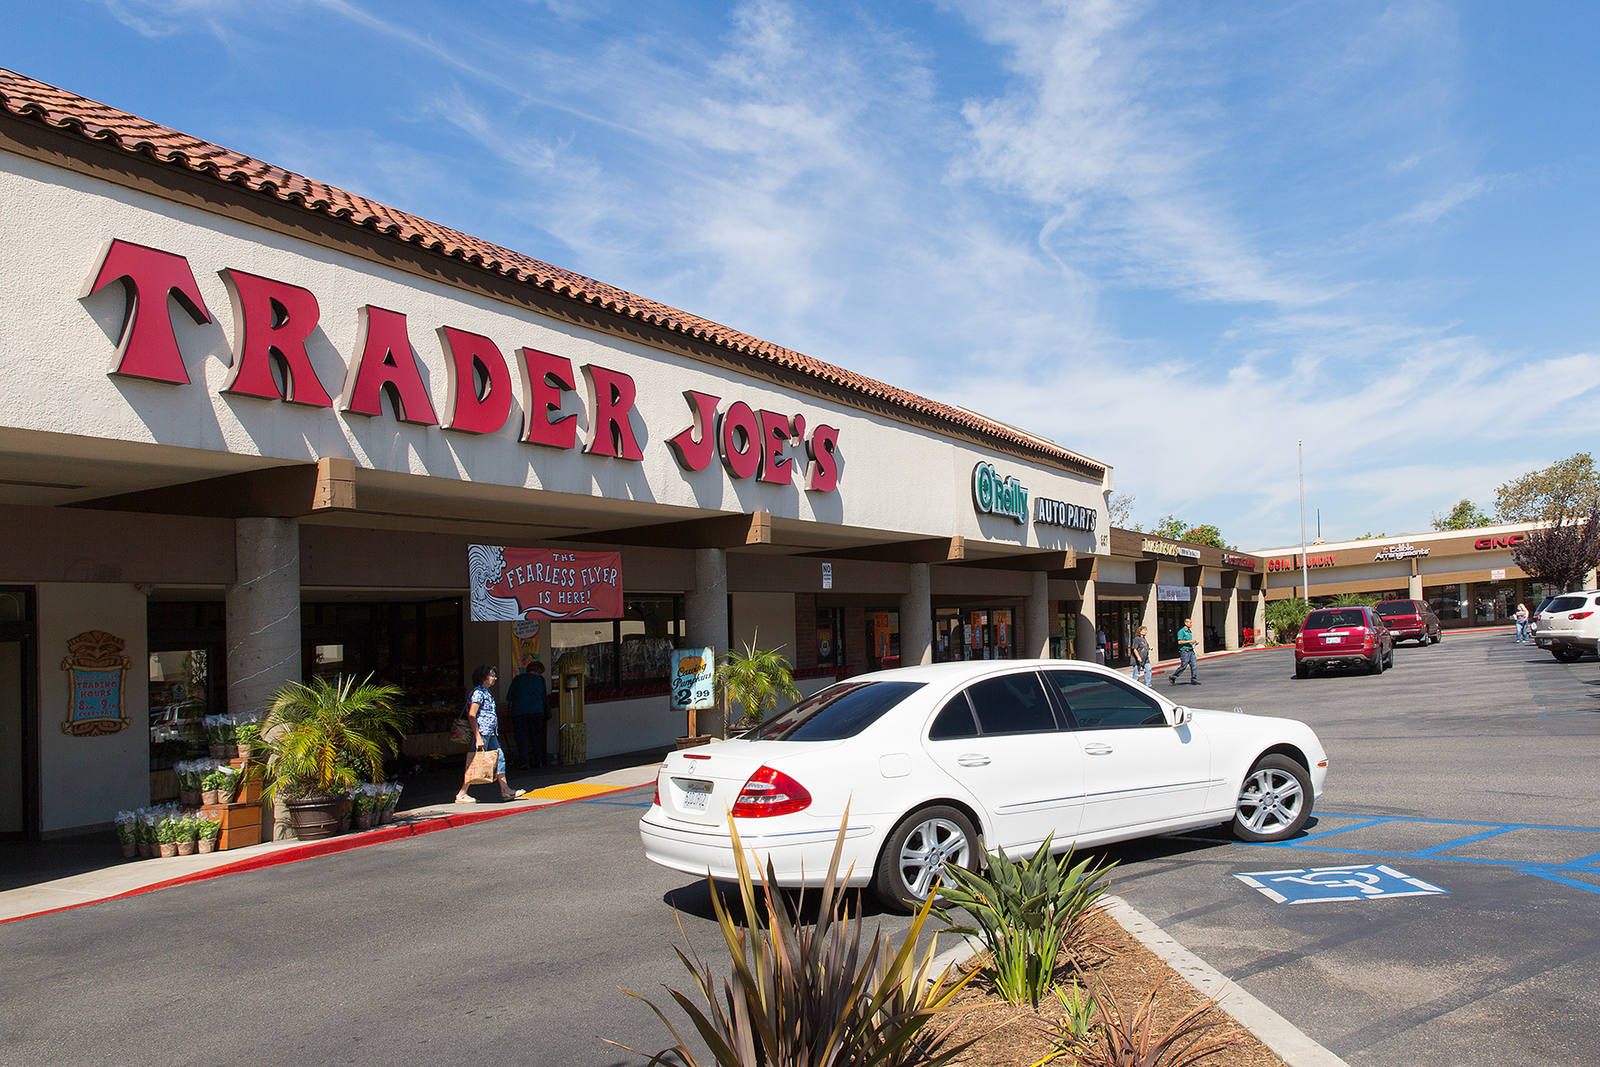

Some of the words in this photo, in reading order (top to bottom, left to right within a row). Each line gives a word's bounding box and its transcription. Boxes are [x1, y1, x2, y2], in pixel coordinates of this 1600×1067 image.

[79, 238, 644, 462] TRADER
[664, 389, 840, 492] JOE'S
[972, 461, 1028, 525] O'Reilly
[1036, 498, 1066, 526] AUTO
[1067, 503, 1097, 532] PARTS
[1389, 543, 1415, 554] Edible
[1475, 535, 1525, 549] GNC
[553, 553, 576, 562] THE
[1374, 548, 1430, 560] Arrangements
[1268, 559, 1290, 571] COIN
[506, 562, 576, 589] FEARLESS
[581, 565, 618, 588] FLYER
[539, 591, 551, 604] IS
[558, 589, 592, 605] HERE!
[77, 681, 117, 689] TRADING
